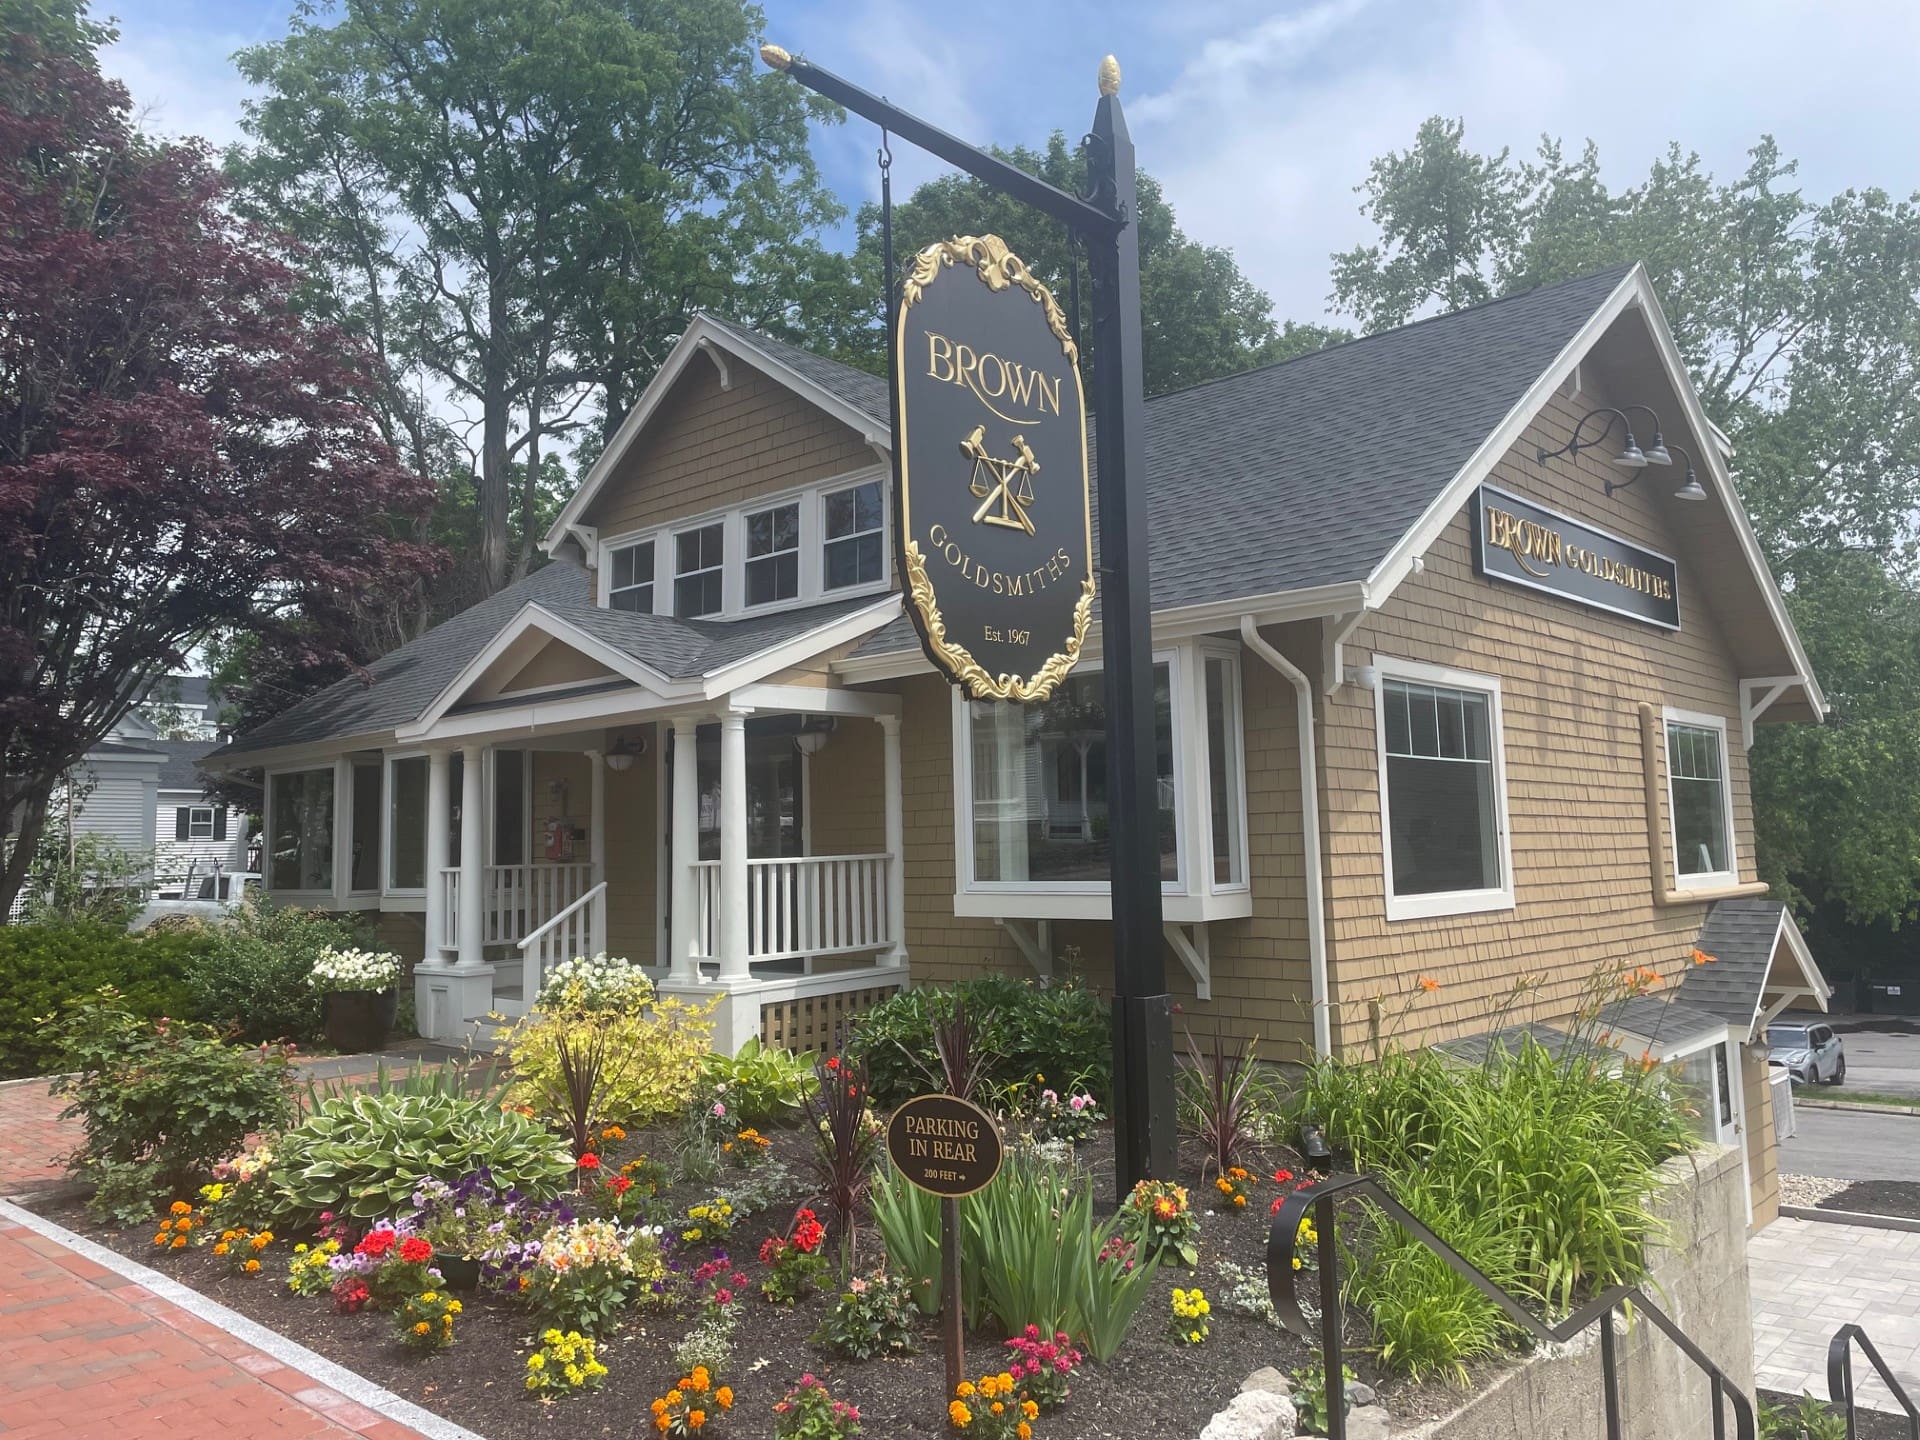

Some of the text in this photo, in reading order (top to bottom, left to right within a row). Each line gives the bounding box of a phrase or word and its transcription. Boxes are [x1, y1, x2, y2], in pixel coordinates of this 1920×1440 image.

[923, 330, 1062, 424] BROWN
[929, 523, 1071, 597] GOLDSMITHS
[1487, 505, 1671, 600] BROWN GOLDSMITHS
[984, 624, 1030, 646] Est. 1967
[905, 1116, 979, 1139] PARKING
[910, 1138, 977, 1162] IN REAR
[924, 1168, 957, 1181] 200 FEET
